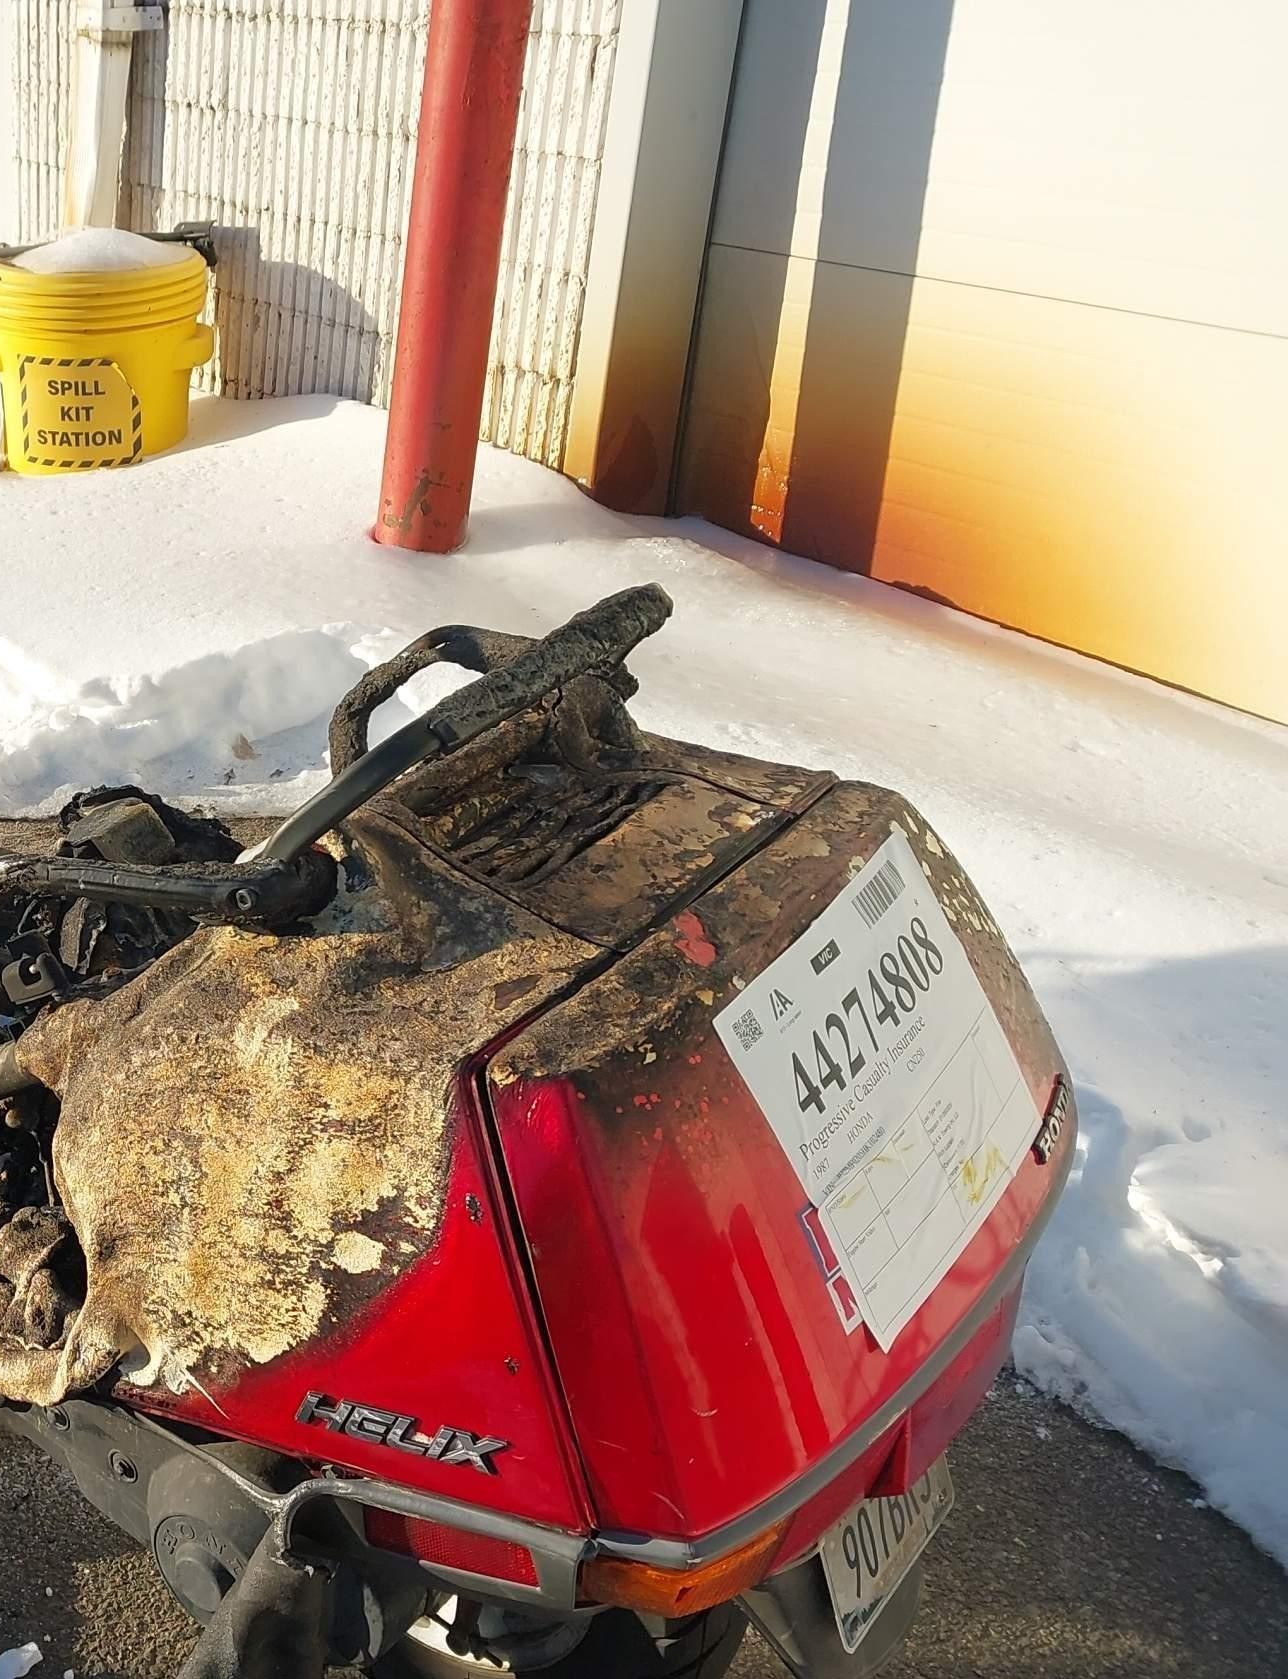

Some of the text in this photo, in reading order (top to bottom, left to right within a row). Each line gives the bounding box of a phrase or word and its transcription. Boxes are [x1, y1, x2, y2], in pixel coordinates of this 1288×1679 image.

[48, 380, 106, 396] SPILL
[60, 406, 94, 422] KIT
[37, 429, 122, 447] STATION
[818, 947, 833, 965] VIC
[791, 916, 943, 1115] 44274808
[799, 1098, 856, 1163] Progressive
[853, 1057, 892, 1104] Casualty
[887, 1015, 926, 1063] Insurance
[812, 1157, 831, 1180] 1987
[846, 1111, 874, 1145] HONDA
[295, 1391, 510, 1475] HELIX
